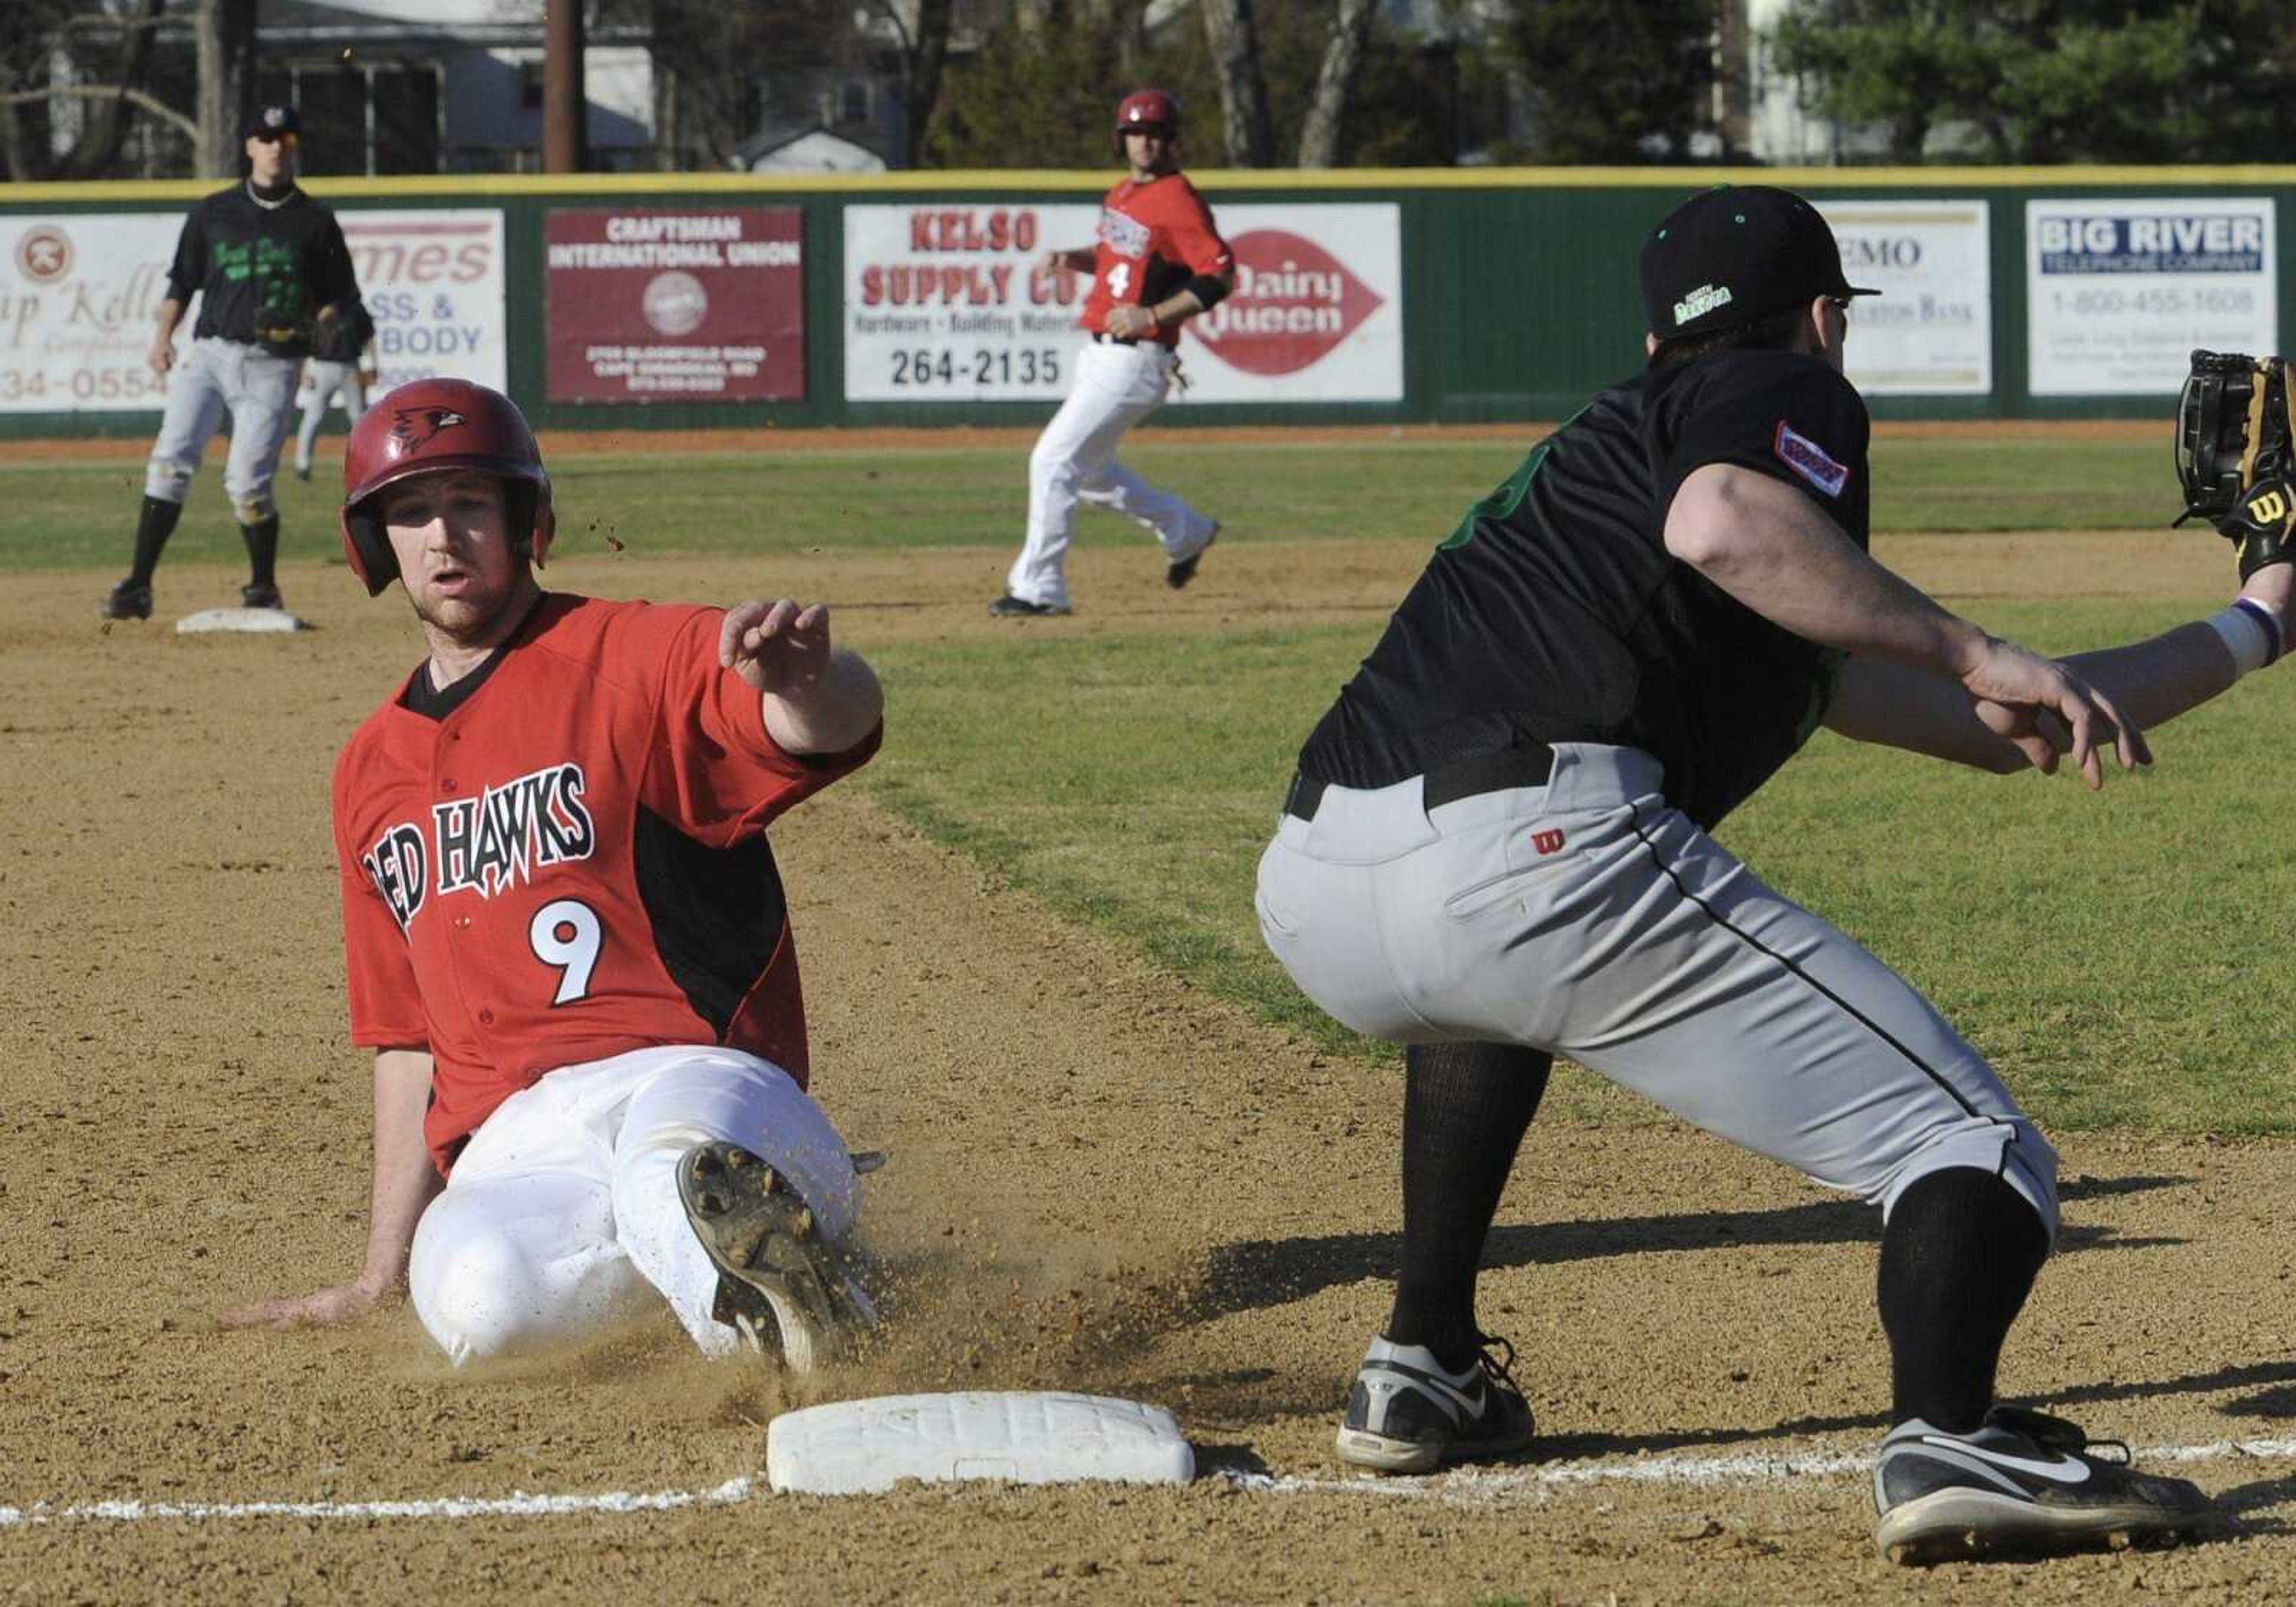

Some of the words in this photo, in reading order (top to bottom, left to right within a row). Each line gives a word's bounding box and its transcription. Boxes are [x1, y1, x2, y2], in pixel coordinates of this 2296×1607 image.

[606, 216, 741, 242] CRAFTSMAN
[911, 212, 1037, 251] KELSO
[2041, 218, 2117, 253] BIG
[2129, 216, 2261, 253] RIVER
[548, 242, 724, 268] INTERNATIONAL
[727, 242, 801, 267] UNION
[863, 265, 1012, 305] SUPPLY
[1107, 262, 1129, 299] 4
[433, 293, 454, 320] &
[1674, 286, 1732, 326] DAKOTA
[951, 313, 1013, 337] Building
[892, 349, 1059, 384] 264-2135
[363, 823, 428, 934] ED
[432, 762, 595, 900] HAWKS
[529, 897, 602, 1007] 9
